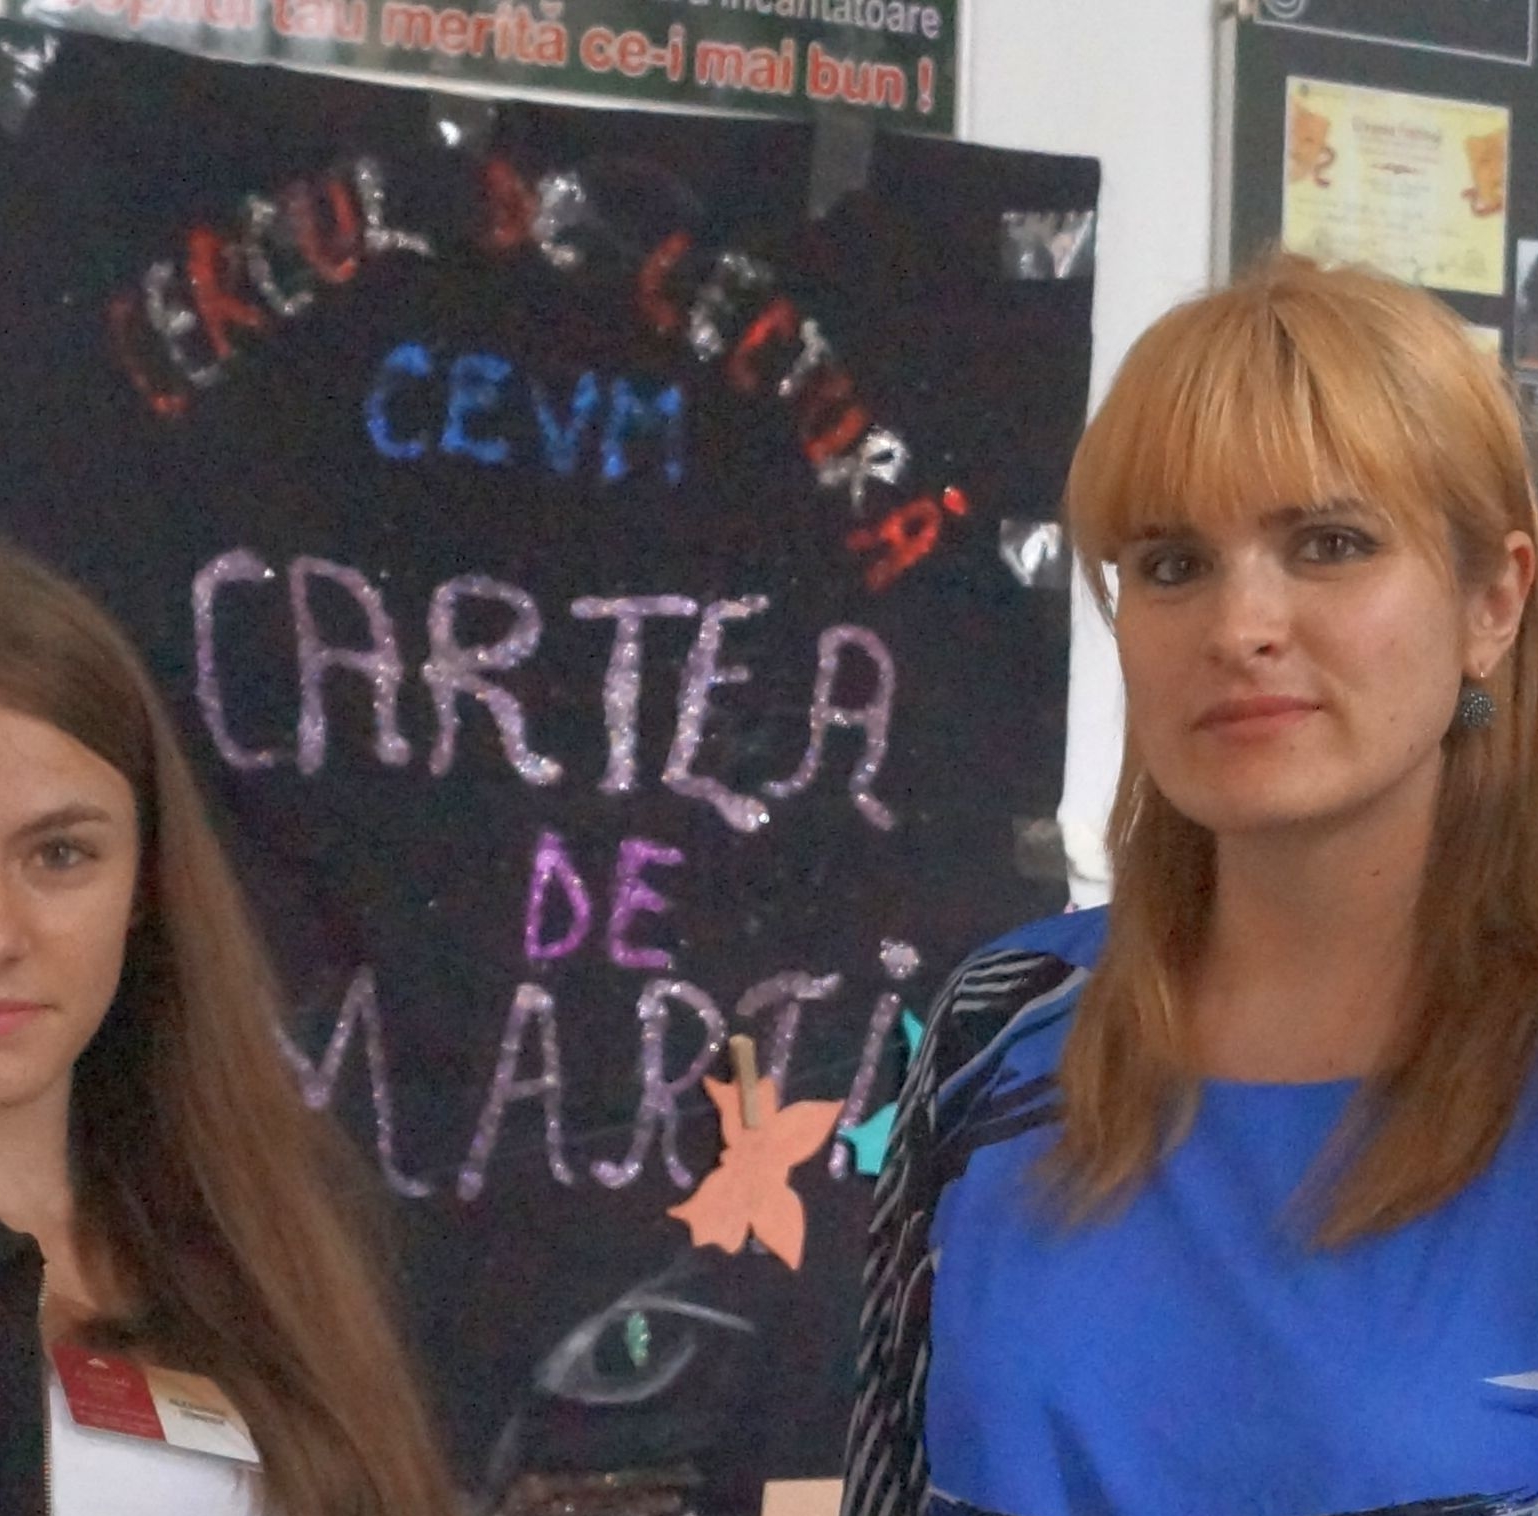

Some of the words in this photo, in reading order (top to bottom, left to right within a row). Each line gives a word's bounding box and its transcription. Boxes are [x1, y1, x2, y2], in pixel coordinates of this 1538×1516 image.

[579, 23, 686, 83] ce-i
[695, 38, 796, 95] mai
[806, 40, 906, 110] bun
[366, 340, 684, 482] CEVM
[192, 546, 898, 832] CARTEA
[525, 831, 684, 967] DE
